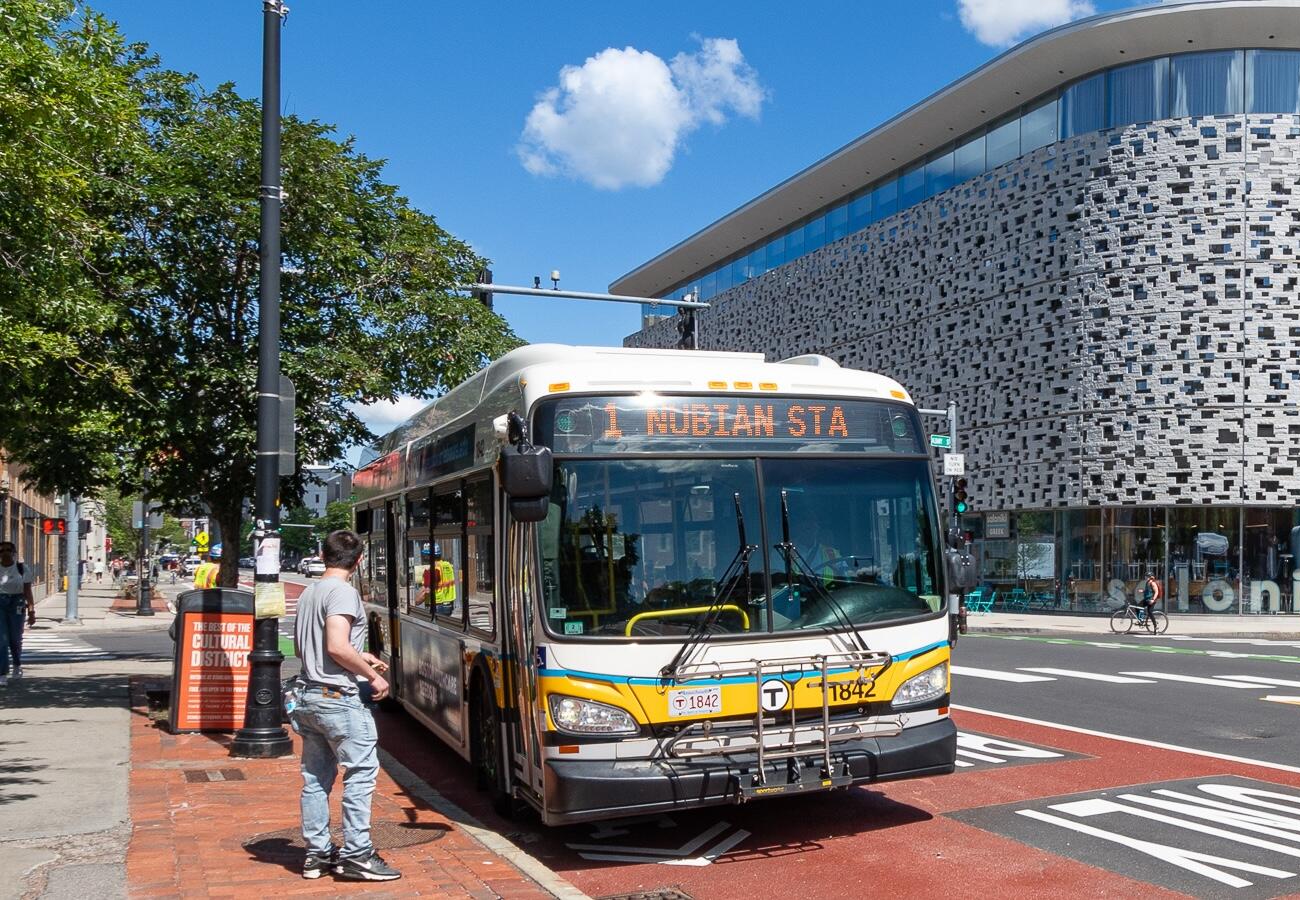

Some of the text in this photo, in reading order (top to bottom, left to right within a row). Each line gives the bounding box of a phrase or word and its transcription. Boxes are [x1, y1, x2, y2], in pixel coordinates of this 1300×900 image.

[603, 402, 848, 438] 1 NUBIAN STA
[192, 621, 251, 633] THE BEST OF THE
[191, 633, 250, 649] CULTURAL
[190, 650, 251, 667] DISTRICT
[763, 687, 783, 707] T
[828, 680, 876, 702] 1842
[689, 693, 719, 709] 1842
